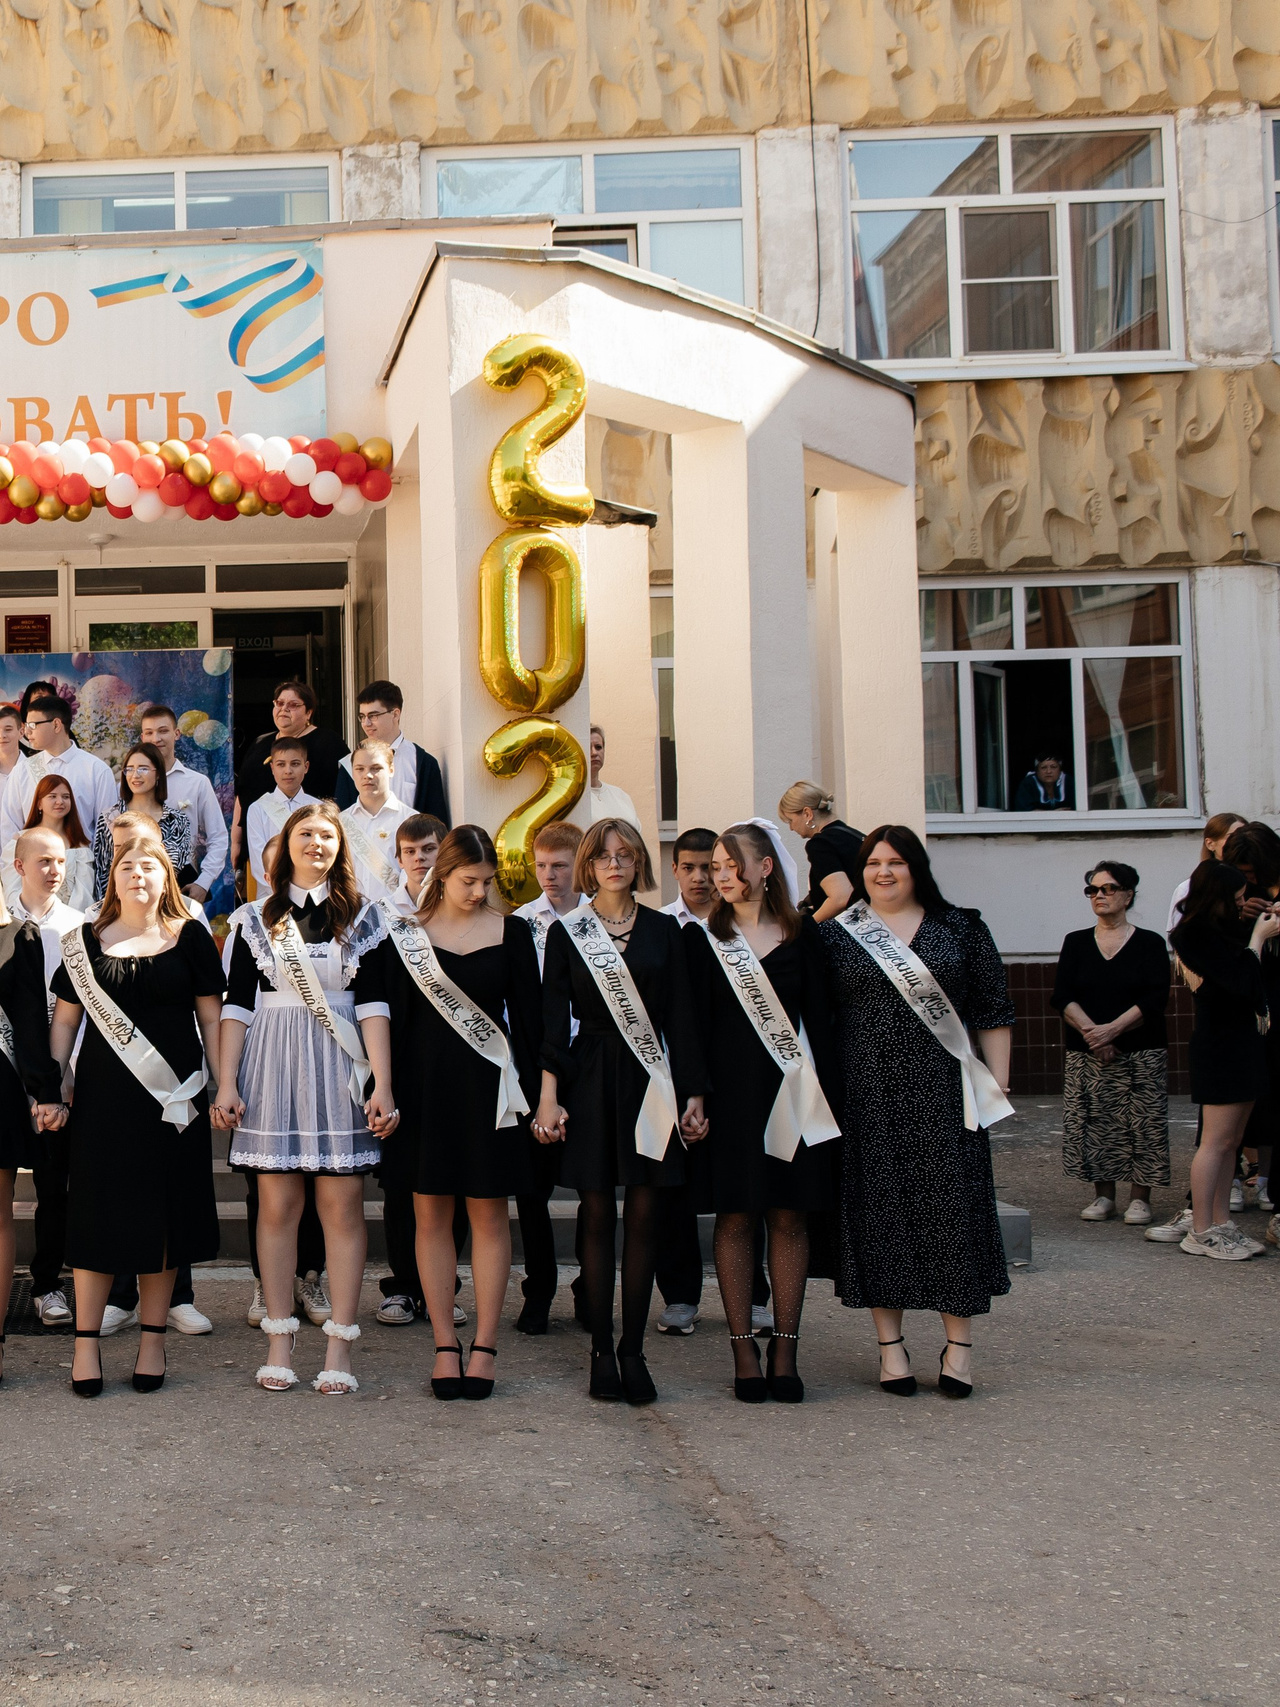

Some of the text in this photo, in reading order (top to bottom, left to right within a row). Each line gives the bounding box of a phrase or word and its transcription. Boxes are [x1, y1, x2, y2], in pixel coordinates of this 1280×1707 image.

[239, 637, 271, 648] ВХОД
[64, 943, 112, 1026] Выпускница
[399, 937, 496, 1042] Выпускник 2025
[582, 941, 662, 1064] Выпускник 2025
[716, 940, 802, 1060] Выпускник 2025
[854, 921, 950, 1020] Выпускник 2025
